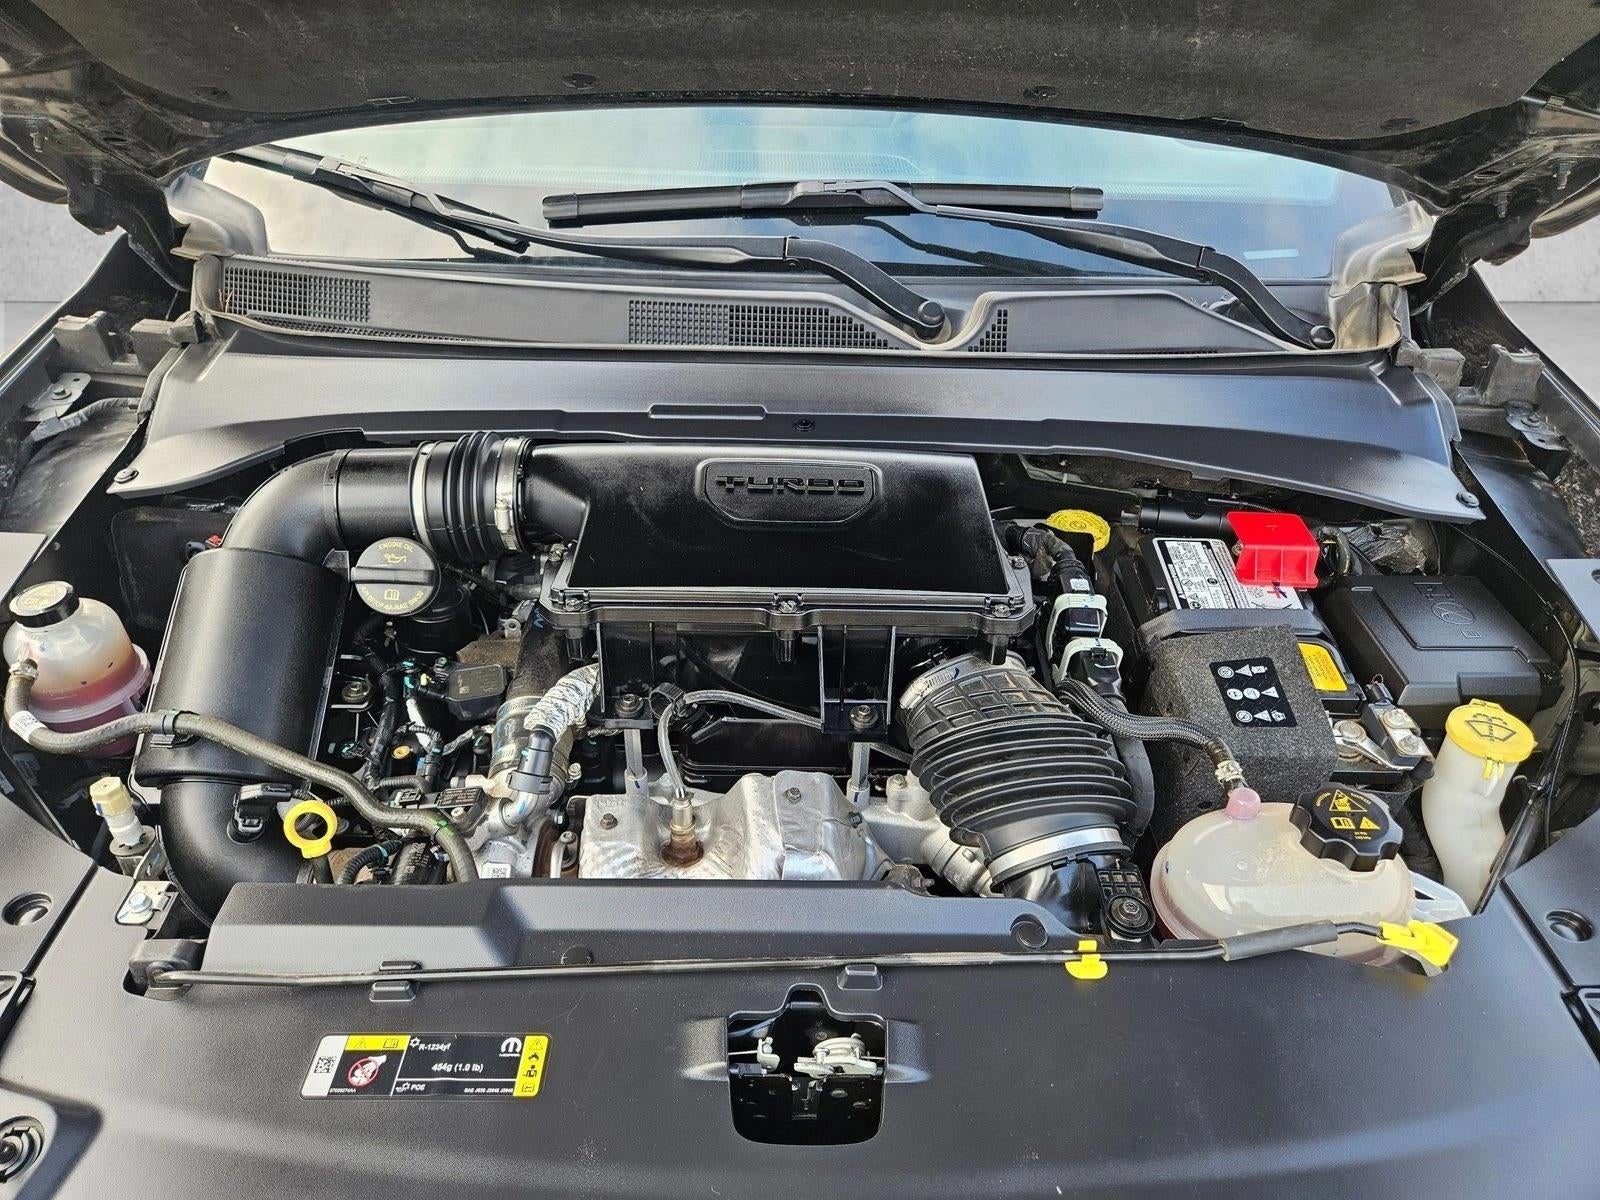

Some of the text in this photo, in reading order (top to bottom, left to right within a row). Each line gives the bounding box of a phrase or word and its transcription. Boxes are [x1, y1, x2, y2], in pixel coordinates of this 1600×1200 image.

[715, 475, 865, 494] TURBO
[378, 541, 414, 553] ENGINE OIL
[418, 1042, 451, 1052] R-1234yf
[431, 1063, 484, 1073] 454g (1.0 lb)
